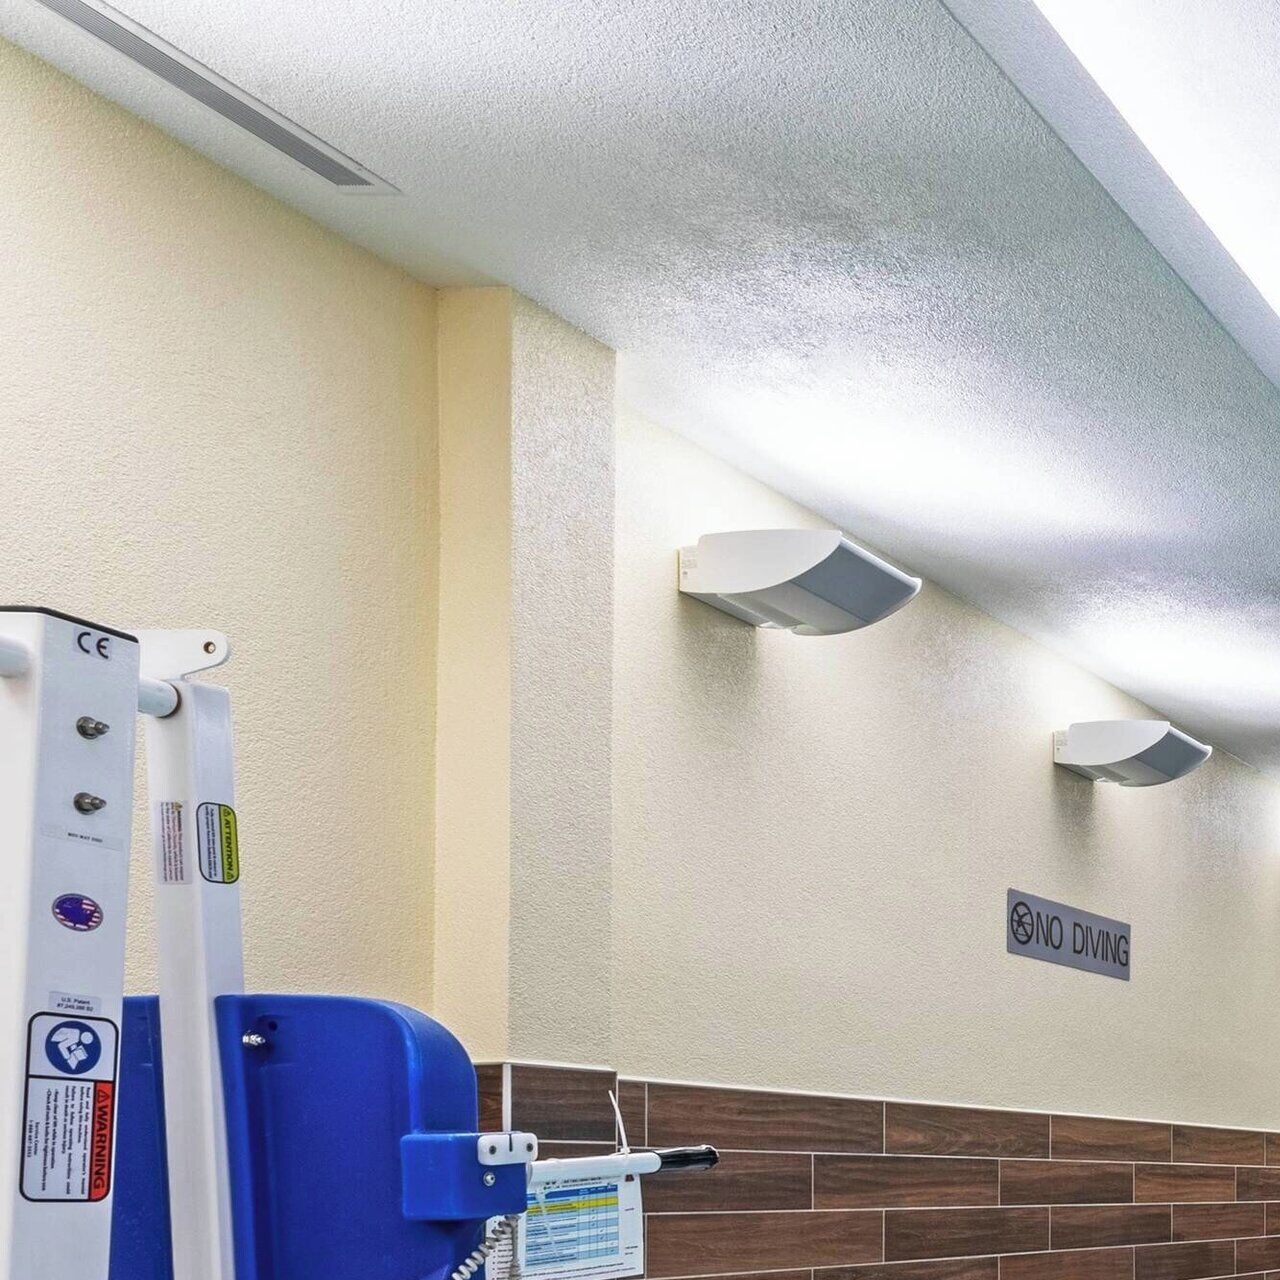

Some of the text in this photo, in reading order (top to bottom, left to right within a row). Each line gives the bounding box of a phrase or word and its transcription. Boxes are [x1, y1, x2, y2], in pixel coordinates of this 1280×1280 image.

[77, 632, 109, 659] CE
[224, 819, 233, 871] ATTENTION
[1036, 912, 1129, 967] NO DIVING
[94, 1105, 108, 1189] WARNING
